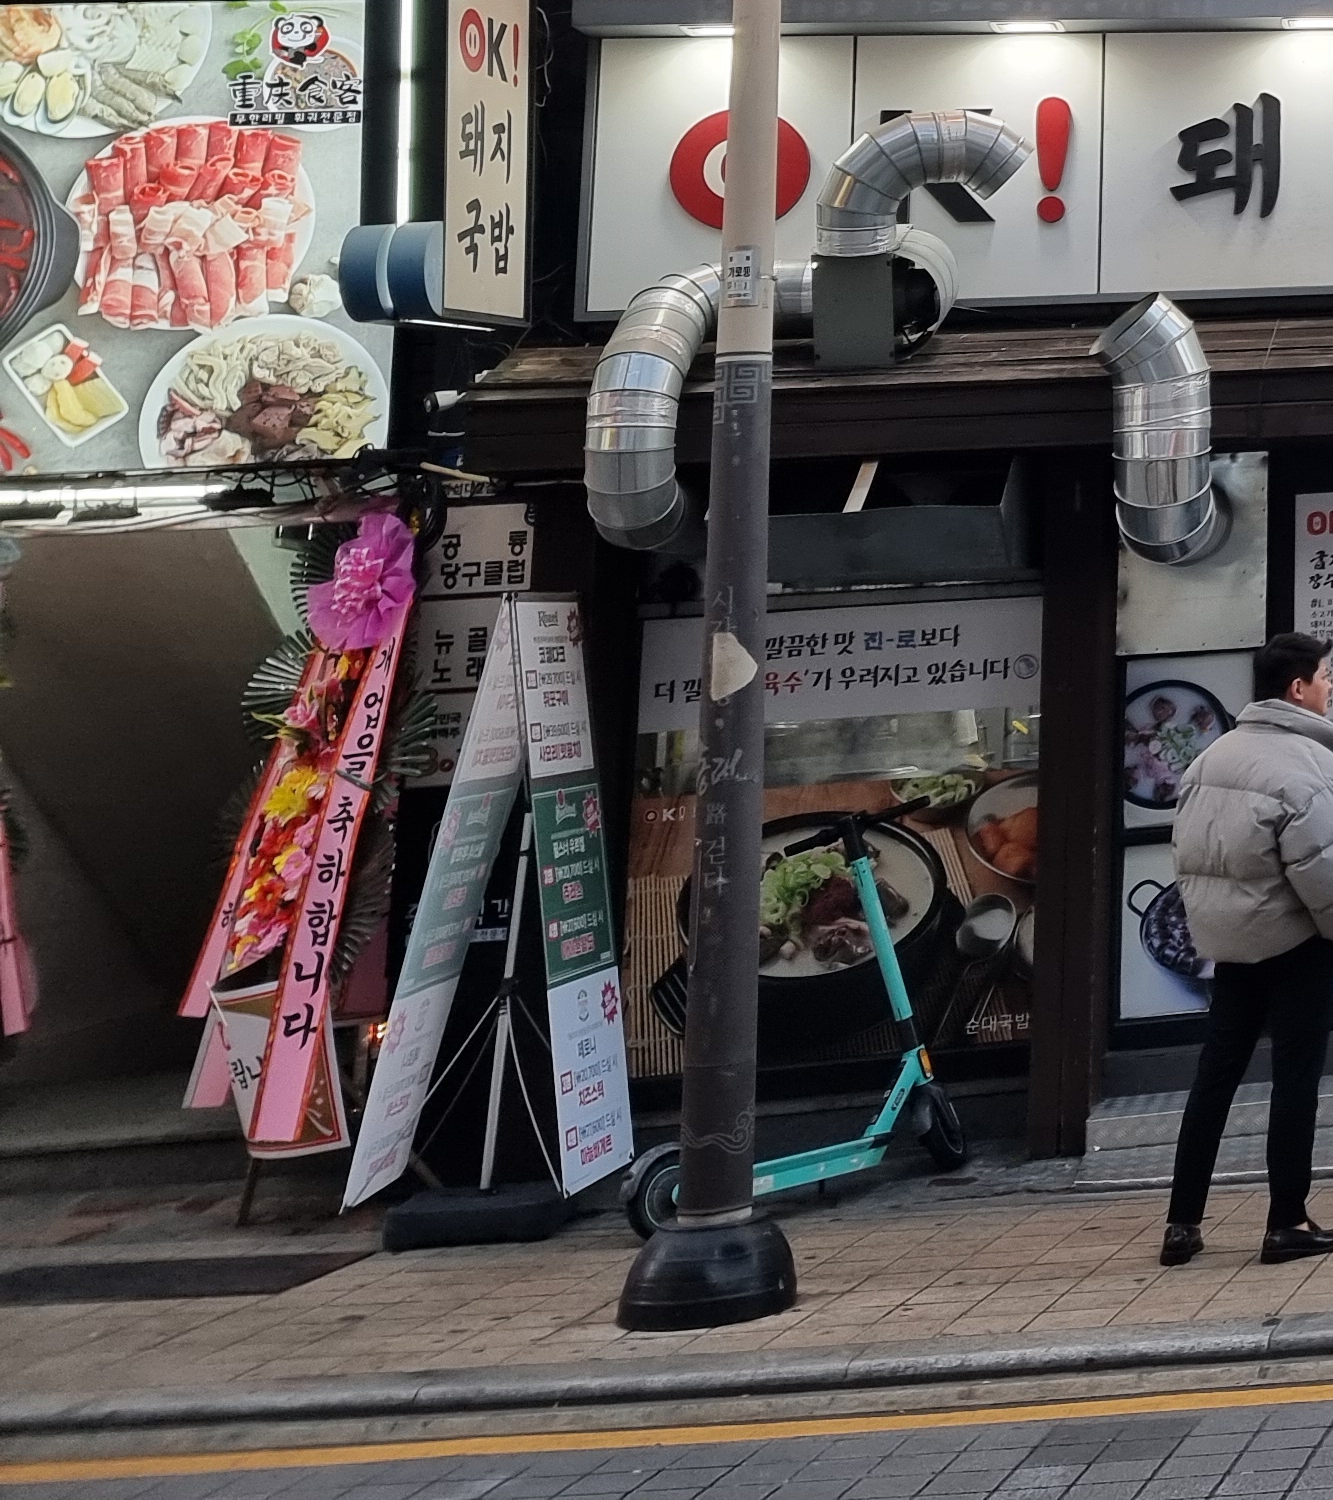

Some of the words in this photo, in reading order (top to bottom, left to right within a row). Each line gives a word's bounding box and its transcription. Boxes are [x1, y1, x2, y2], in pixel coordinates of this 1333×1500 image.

[457, 99, 514, 185] 돼지
[456, 196, 516, 279] 국밥
[439, 559, 528, 591] 당구클럽
[832, 630, 856, 656] 맛
[926, 657, 1012, 686] 있습니다
[282, 795, 355, 1051] 축하합니다
[964, 1011, 1031, 1035] 순대국밥
